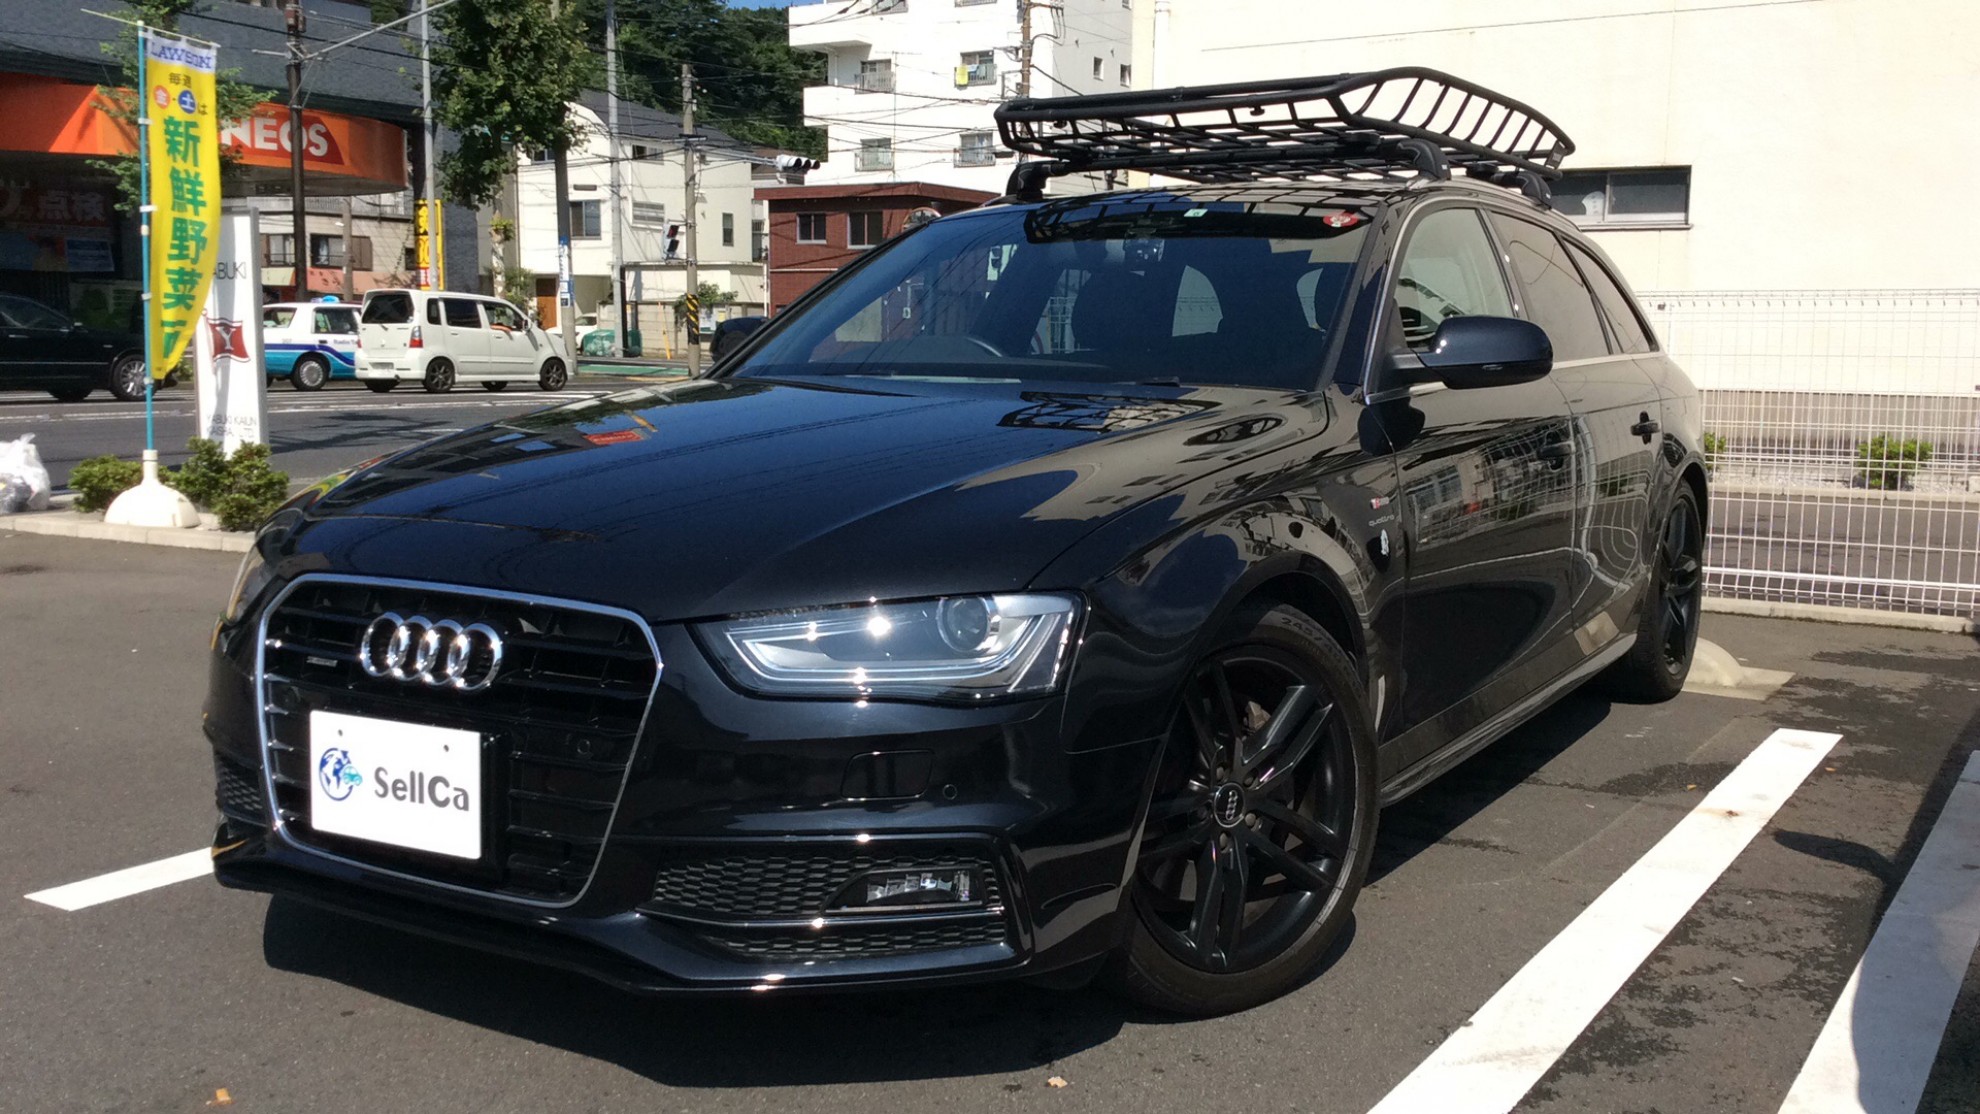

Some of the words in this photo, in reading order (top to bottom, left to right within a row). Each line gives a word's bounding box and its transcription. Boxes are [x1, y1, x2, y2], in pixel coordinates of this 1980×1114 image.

[150, 42, 212, 70] LAWSON
[215, 326, 237, 351] Y
[1368, 514, 1395, 527] quattro
[374, 766, 470, 811] SellCa
